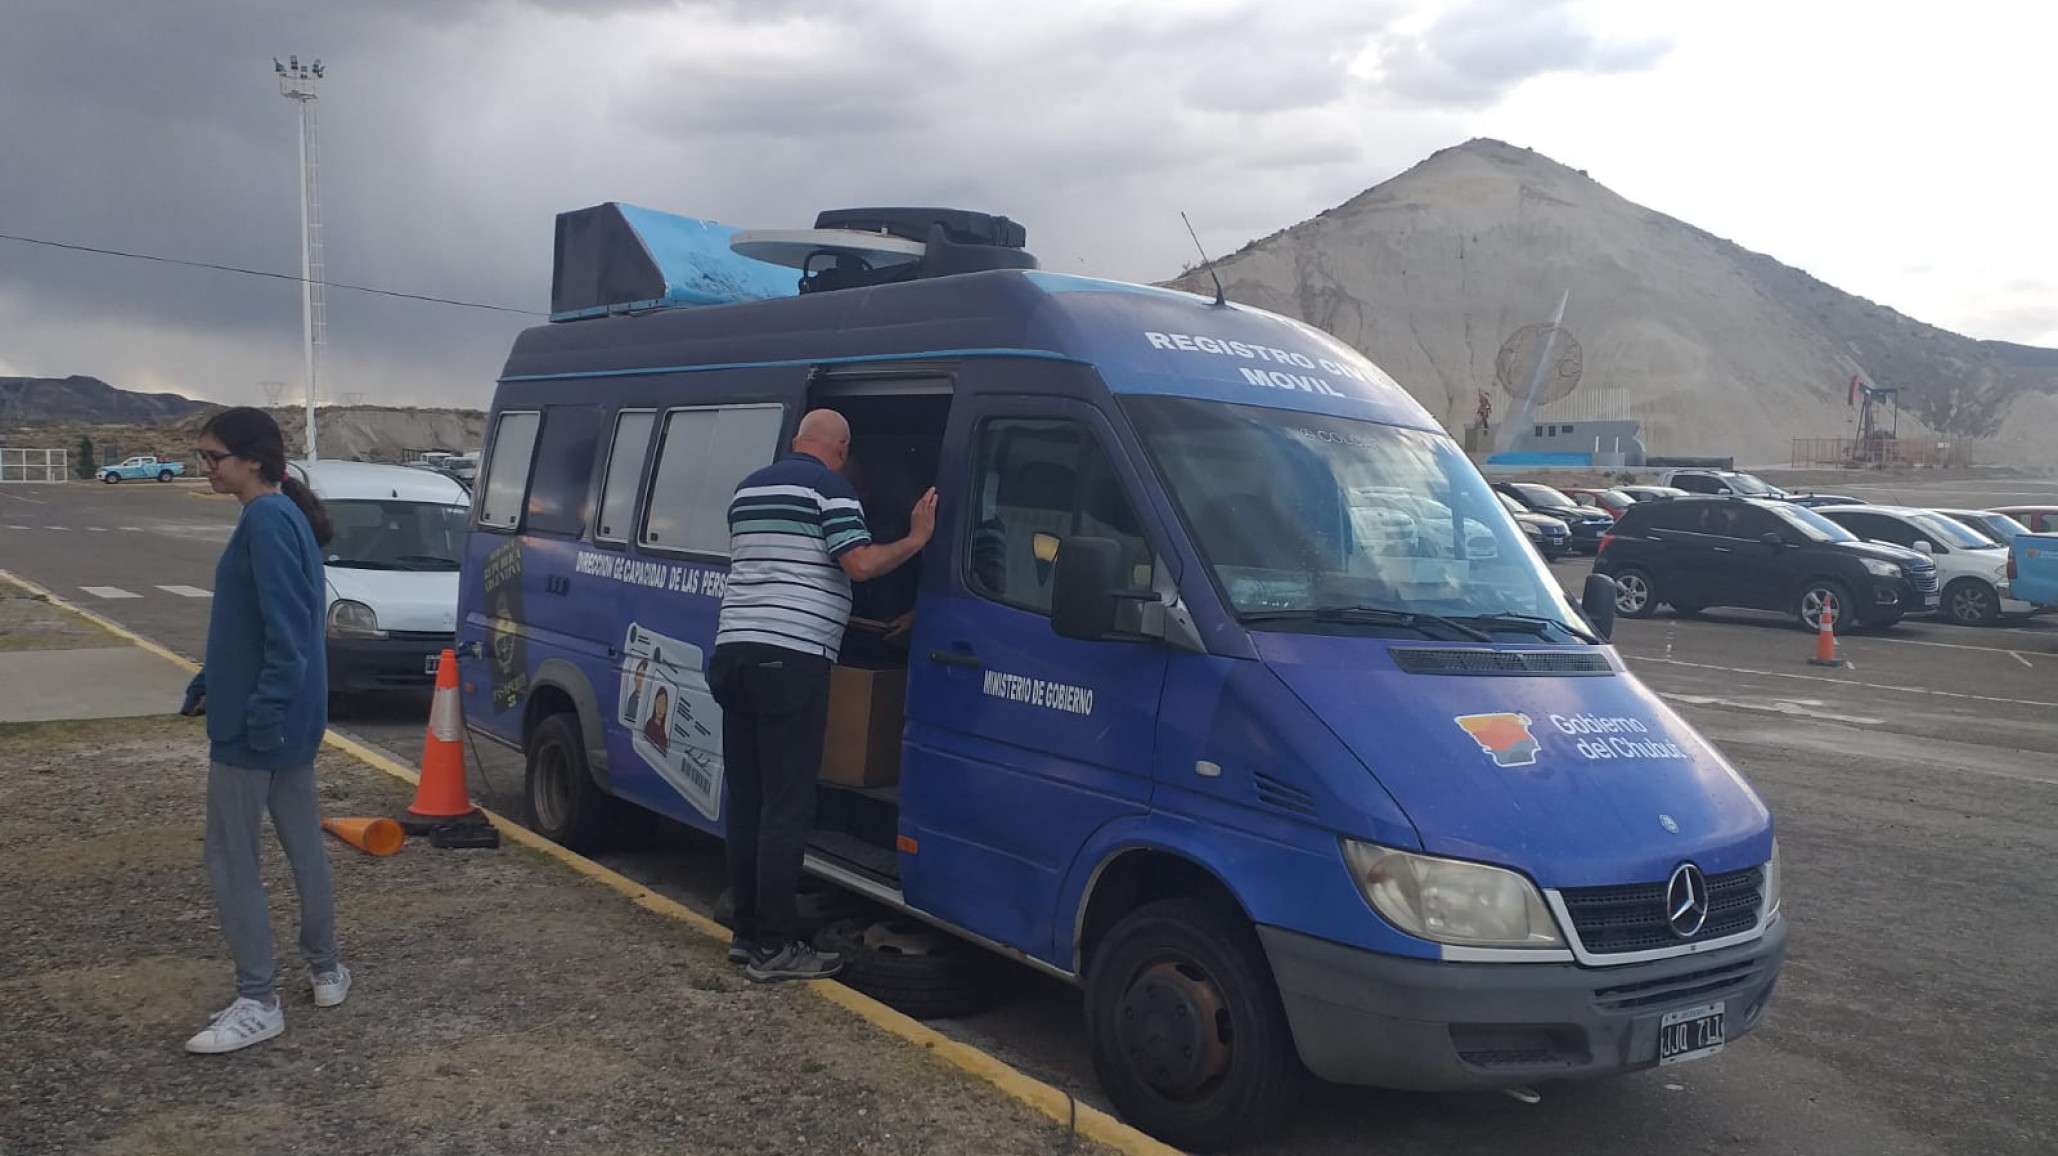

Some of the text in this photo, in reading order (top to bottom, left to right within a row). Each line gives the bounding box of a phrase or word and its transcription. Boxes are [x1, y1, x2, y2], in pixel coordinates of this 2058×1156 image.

[1144, 331, 1316, 370] REGISTRO
[1239, 367, 1345, 398] MOVIL
[623, 559, 667, 588] CAPACIDAD
[668, 566, 683, 591] DE
[681, 568, 700, 594] LAS
[983, 669, 1093, 716] MINISTERIO DE GOBIERNO
[1549, 712, 1648, 735] Gobierno
[1576, 736, 1687, 759] del Chubut
